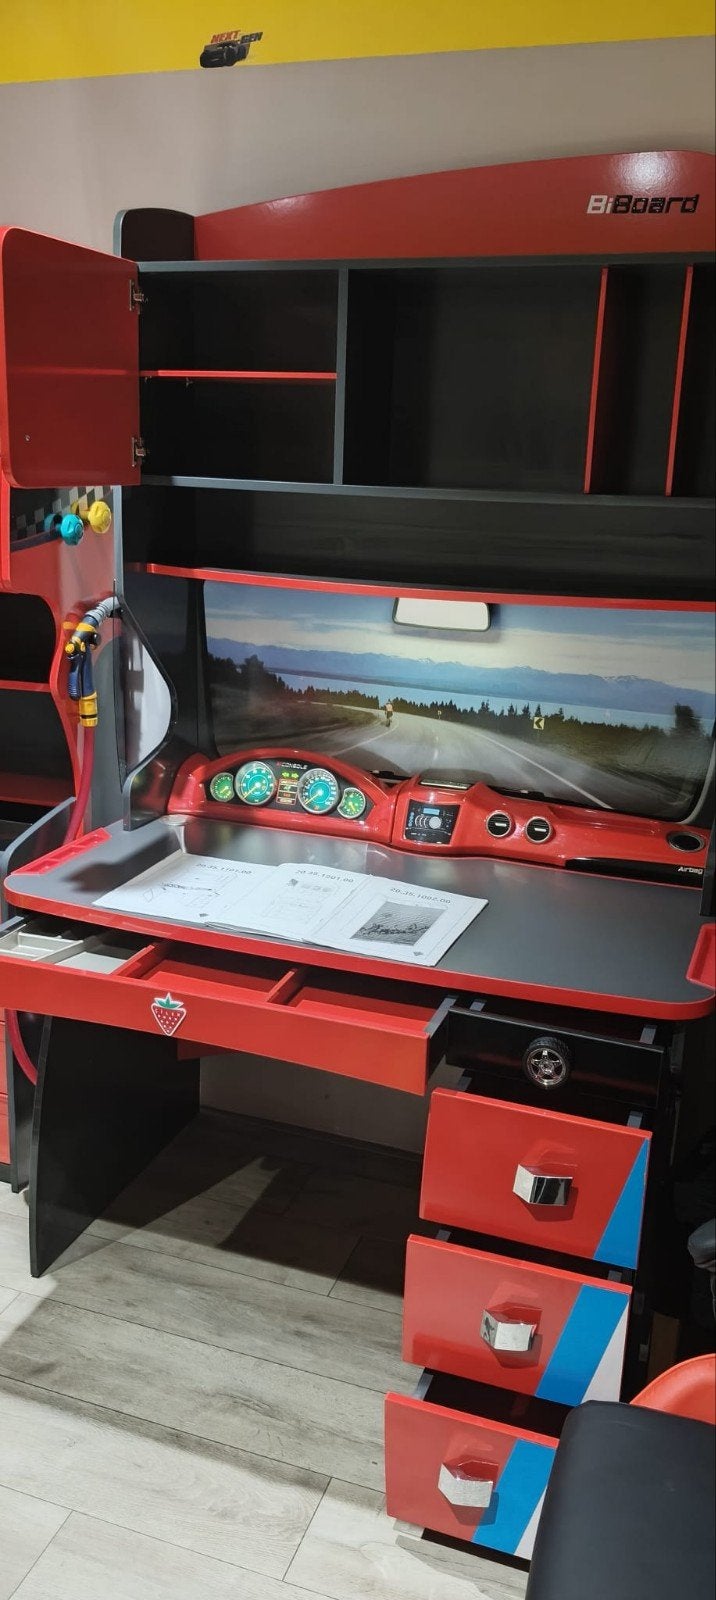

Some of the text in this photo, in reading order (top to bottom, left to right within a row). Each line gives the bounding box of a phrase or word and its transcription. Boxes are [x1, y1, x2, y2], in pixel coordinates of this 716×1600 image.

[211, 30, 263, 44] NEXT GEN
[587, 194, 700, 214] BiBoard
